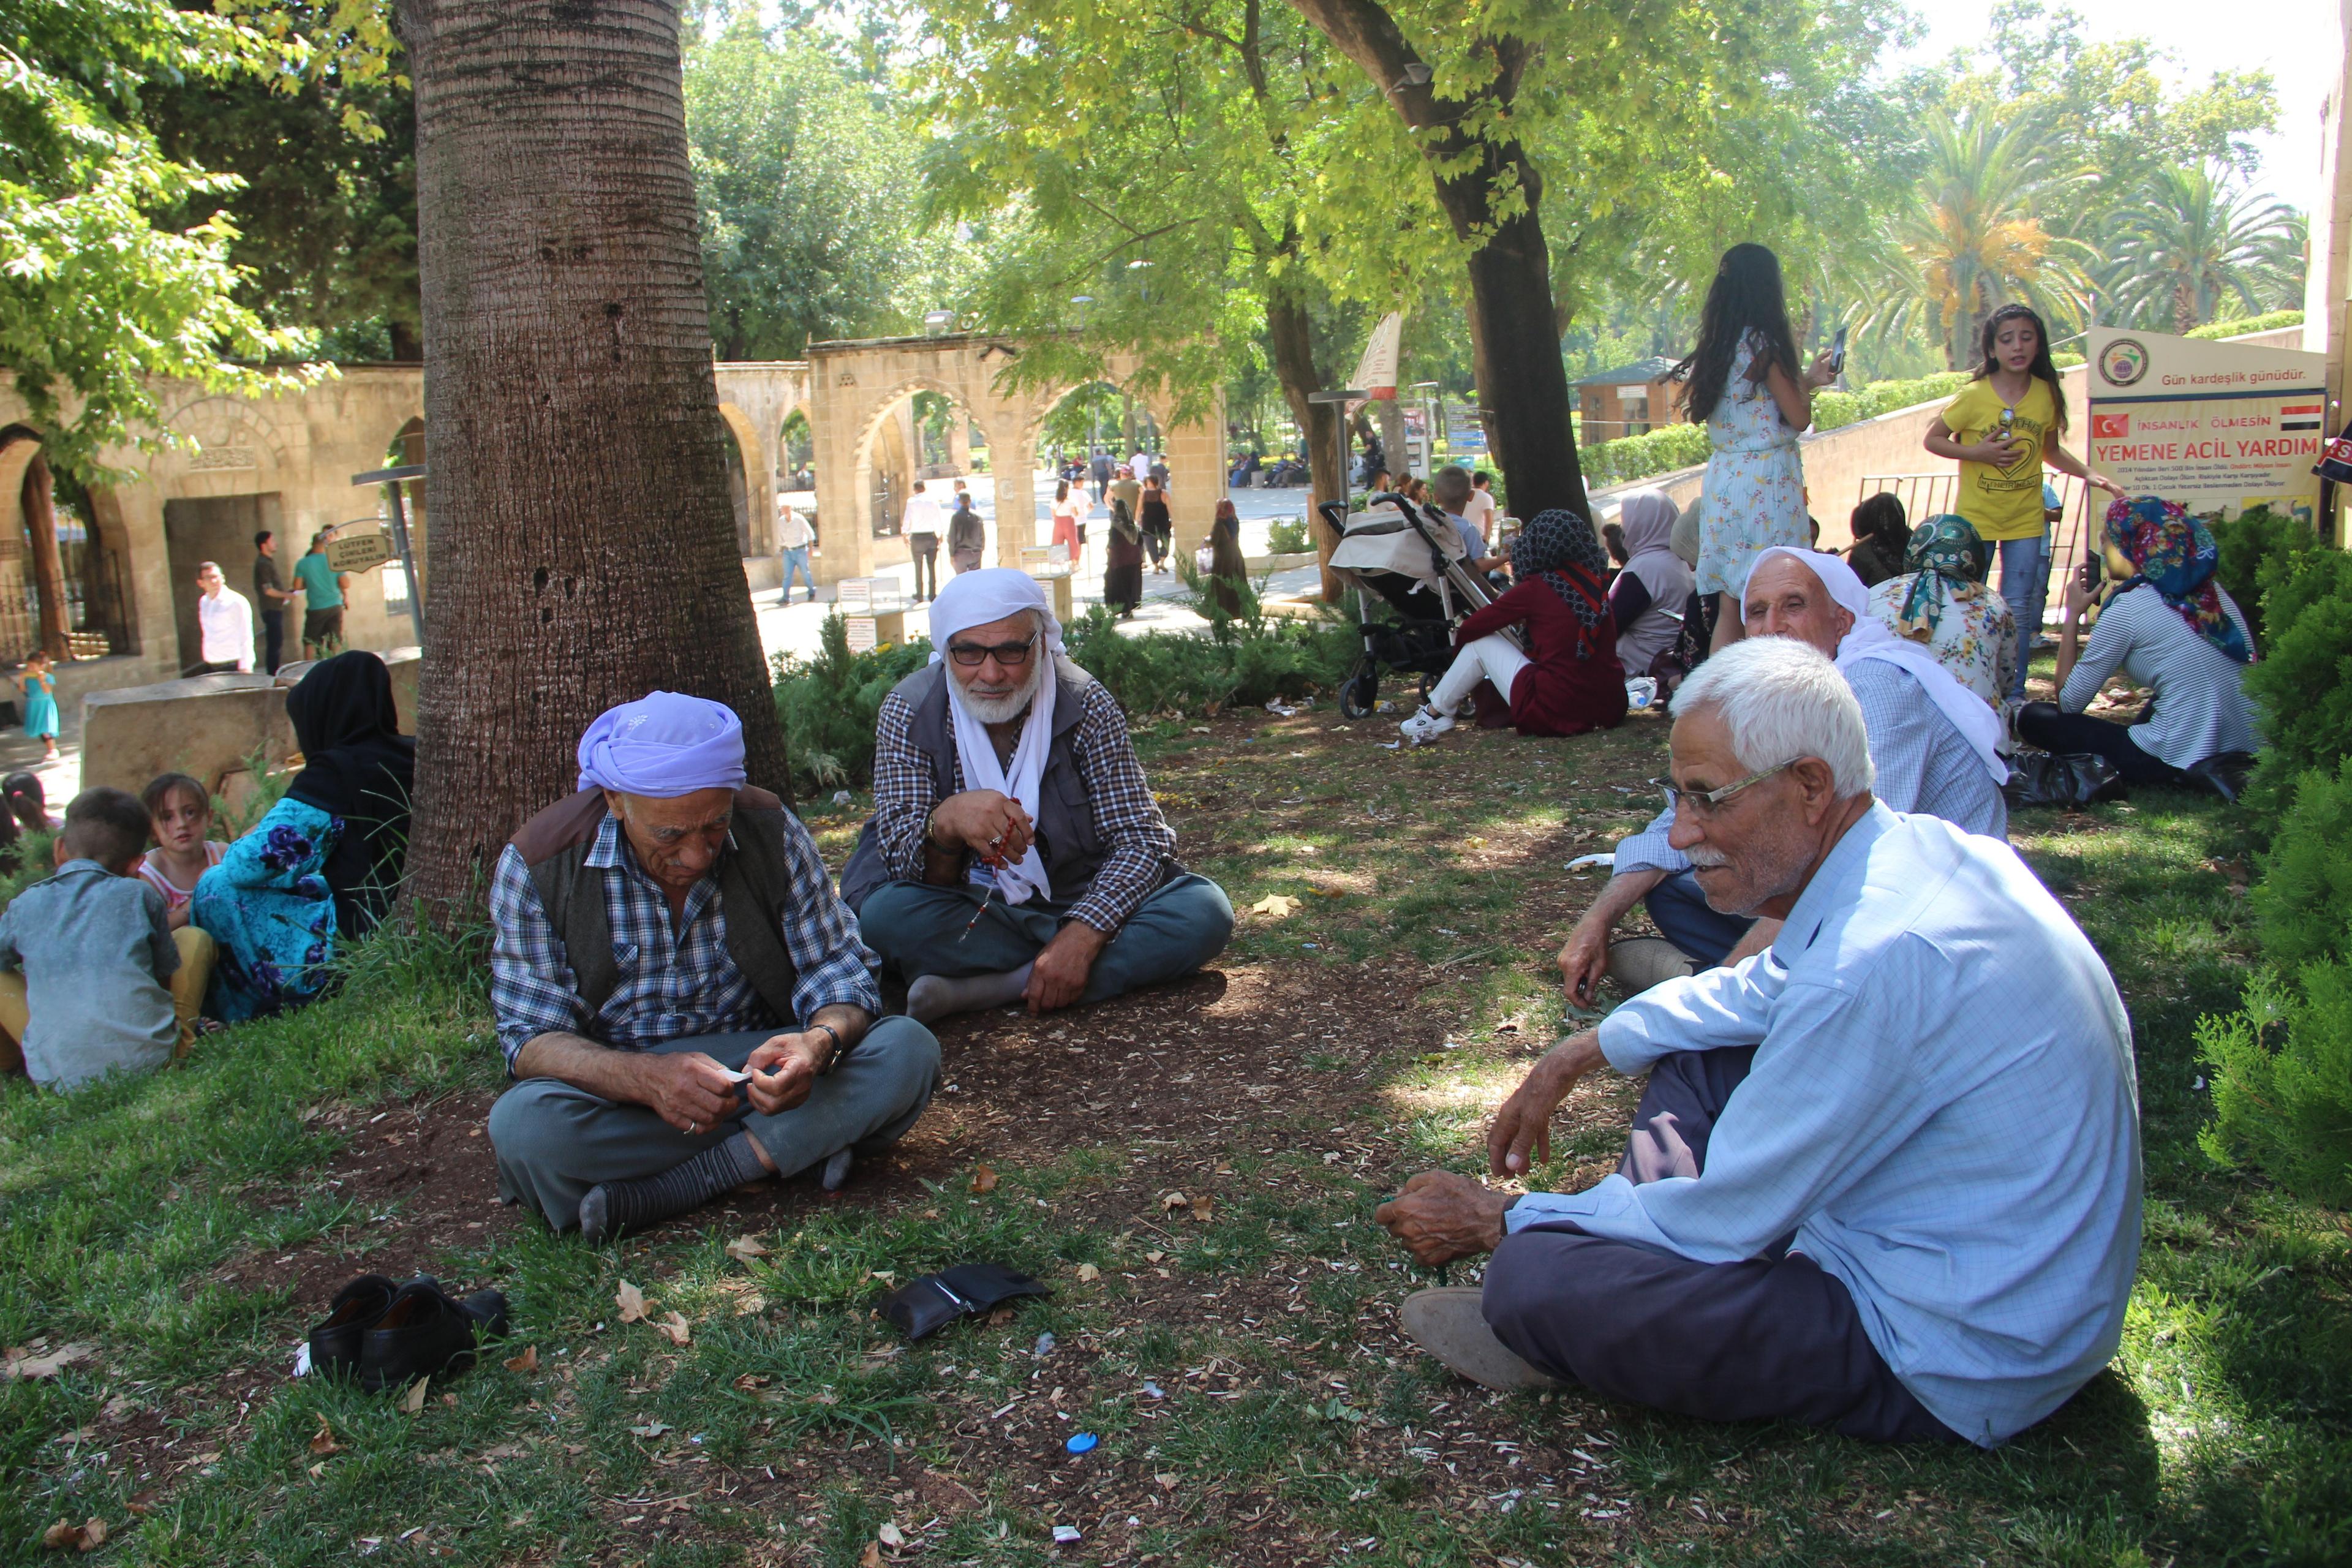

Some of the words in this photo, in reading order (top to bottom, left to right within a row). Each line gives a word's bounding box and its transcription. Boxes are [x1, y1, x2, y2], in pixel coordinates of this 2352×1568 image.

[2162, 374, 2186, 385] Gün
[2190, 372, 2246, 385] kardeşlik
[2250, 369, 2306, 384] günüdür.
[2137, 420, 2199, 431] İNSANLIK
[2211, 415, 2271, 428] ÖLMESİN
[2096, 443, 2177, 462] YEMENE
[2184, 437, 2231, 459] ACİL
[2236, 437, 2317, 458] YARDIM
